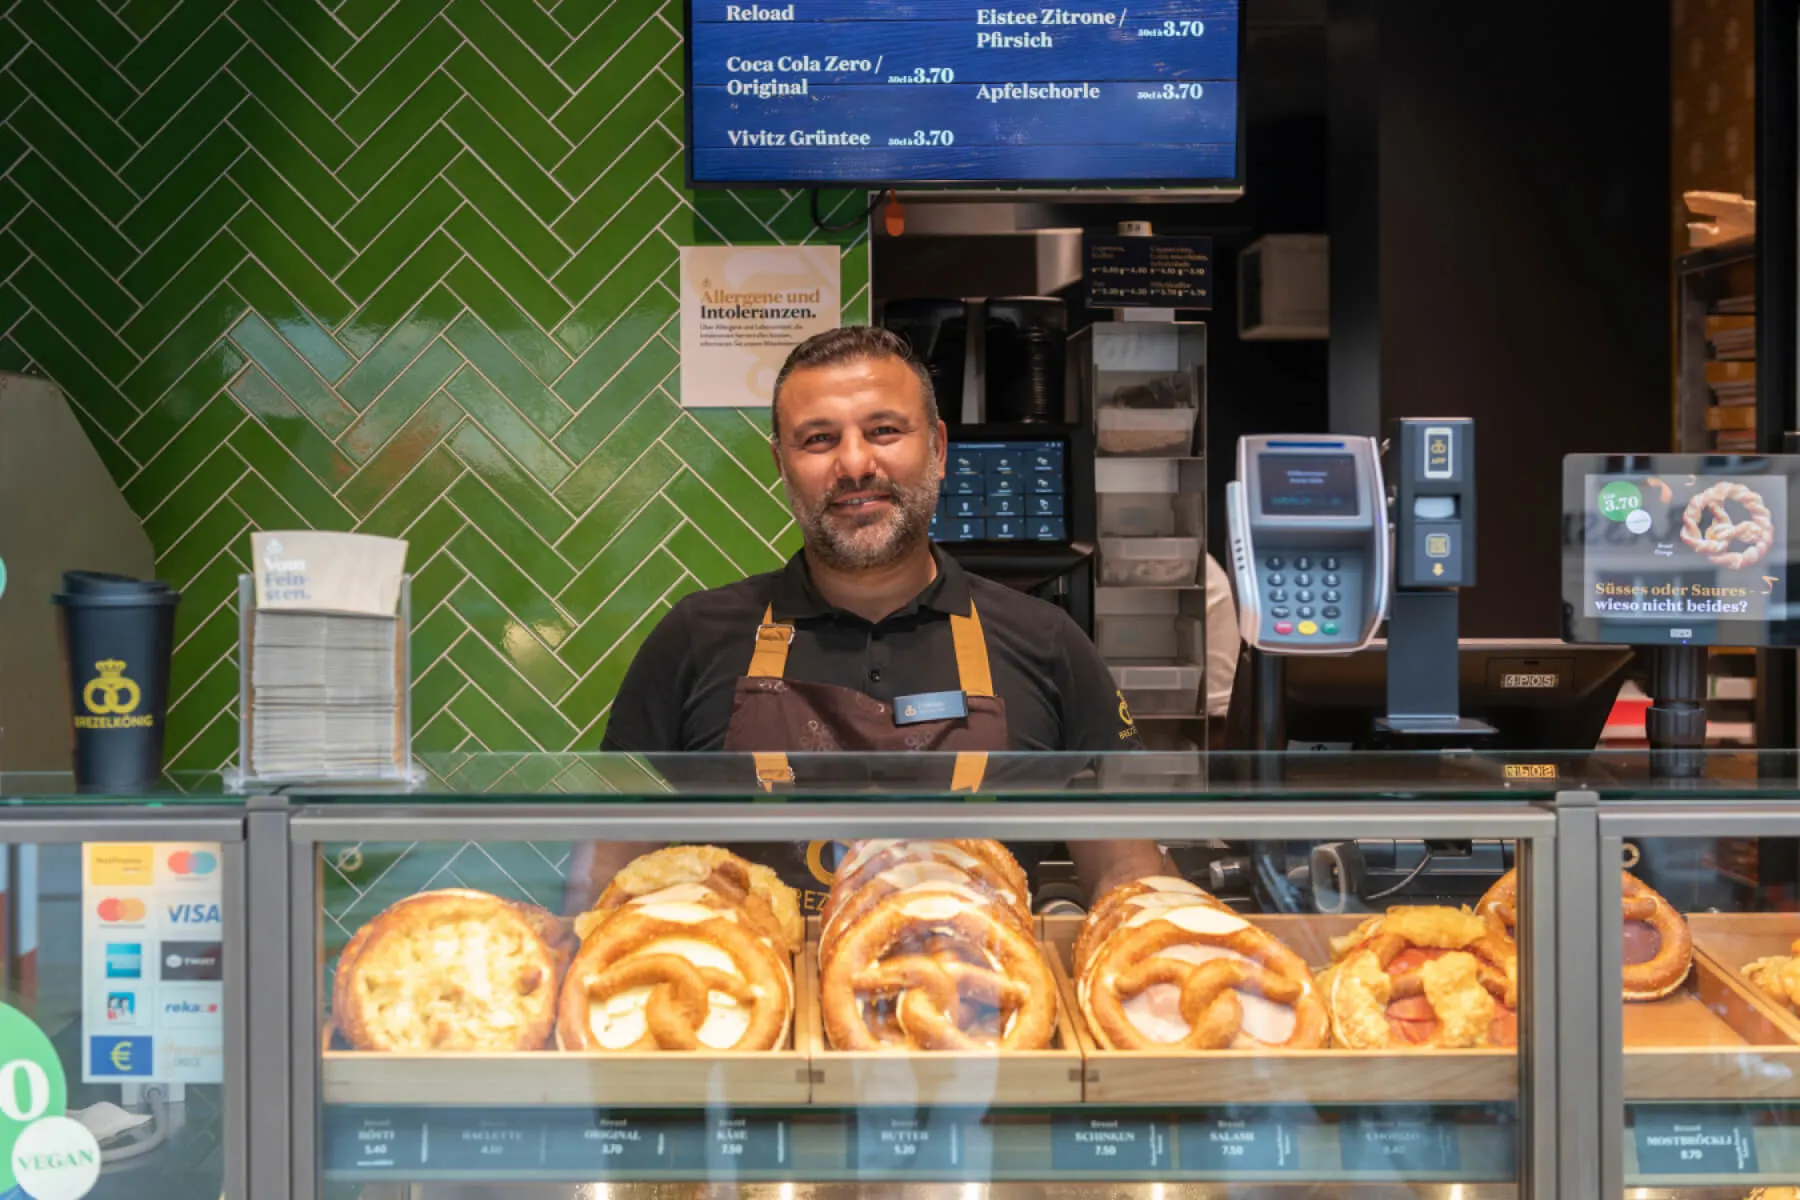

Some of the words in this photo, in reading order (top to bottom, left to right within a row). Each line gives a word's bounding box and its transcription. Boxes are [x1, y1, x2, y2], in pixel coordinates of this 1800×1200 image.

[727, 4, 795, 21] Reload
[976, 9, 1031, 25] Eistee
[1040, 9, 1116, 25] Zitrone
[1119, 7, 1127, 28] /
[1163, 20, 1204, 37] 3.70
[976, 32, 1053, 48] Pfirsich
[726, 56, 774, 72] Coca
[777, 55, 821, 72] Cola
[825, 56, 872, 72] Zero
[874, 55, 883, 75] /
[913, 68, 954, 84] 3.70
[727, 78, 808, 98] Original
[976, 83, 1101, 103] Apfelschorle
[1162, 84, 1203, 100] 3.70
[727, 130, 786, 146] Vivitz
[789, 129, 871, 146] Grüntee
[913, 130, 954, 146] 3.70
[701, 289, 783, 306] Allergene
[787, 288, 820, 304] und
[701, 304, 817, 320] Intoleranzen.
[1605, 495, 1639, 512] 3.70
[1595, 582, 1648, 596] Süsses
[1651, 583, 1688, 596] oder
[1691, 583, 1747, 597] Saures
[1595, 598, 1639, 611] wieso
[1642, 598, 1684, 612] nicht
[1687, 599, 1749, 613] beides?
[167, 903, 223, 924] VISA
[17, 1147, 95, 1172] VEGAN
